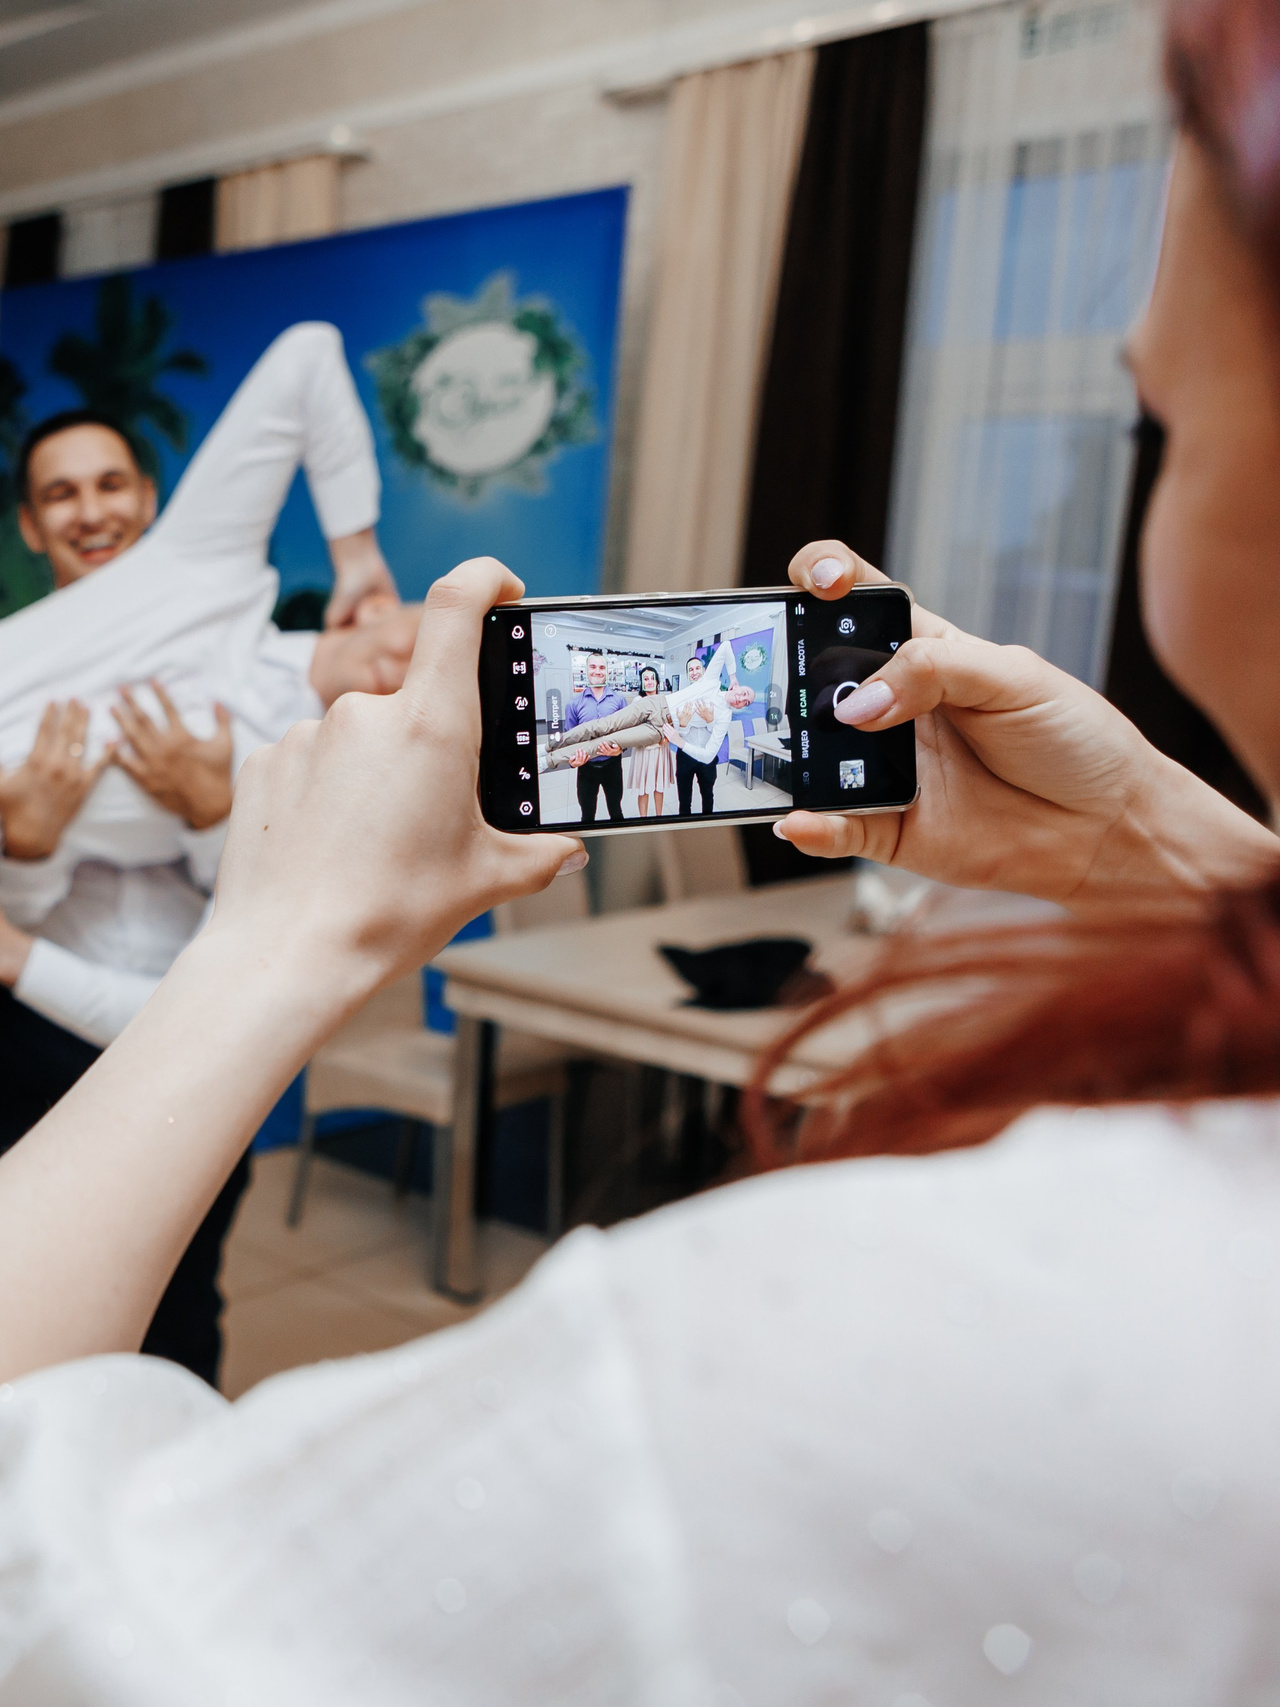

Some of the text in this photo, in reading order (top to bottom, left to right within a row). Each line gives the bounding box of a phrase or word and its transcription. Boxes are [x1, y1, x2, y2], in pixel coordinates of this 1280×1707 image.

[798, 639, 806, 676] КРАСОТА
[799, 689, 807, 707] CAM
[801, 730, 809, 758] ВИДЕО
